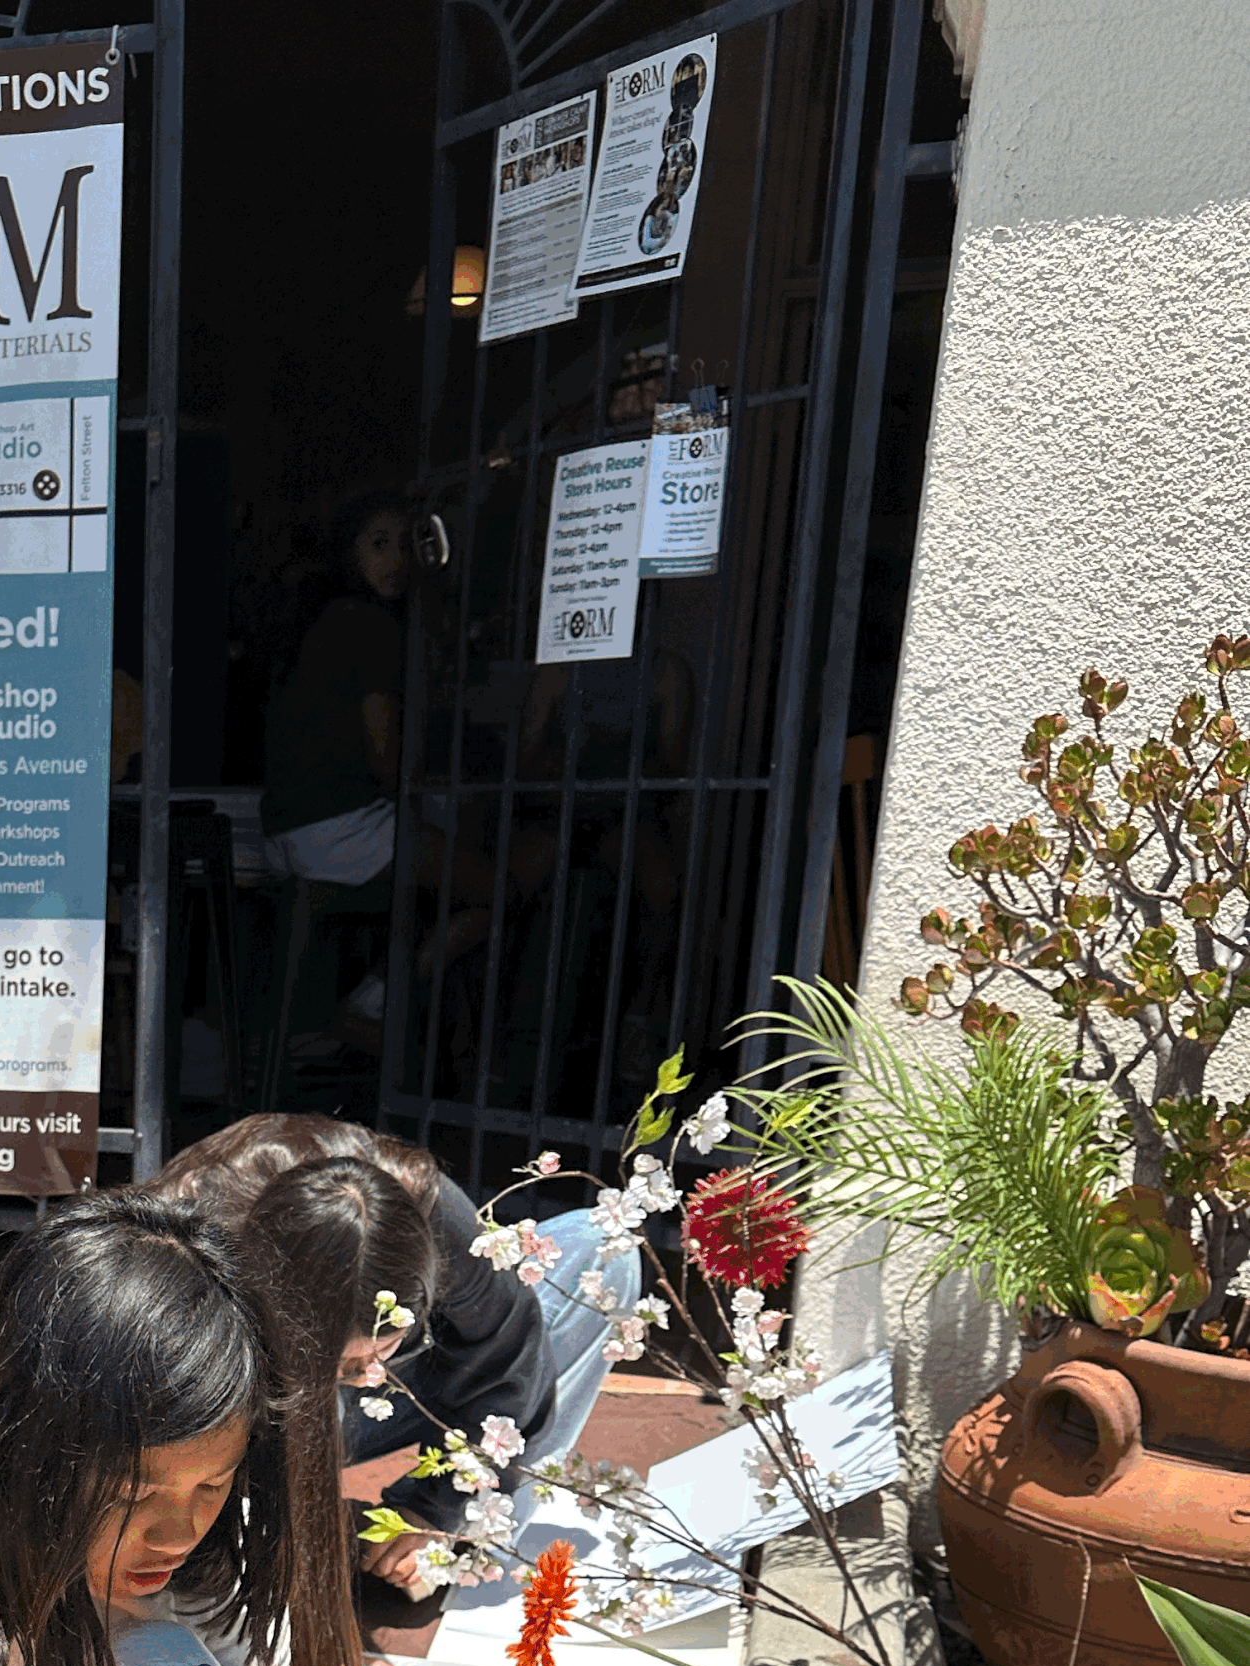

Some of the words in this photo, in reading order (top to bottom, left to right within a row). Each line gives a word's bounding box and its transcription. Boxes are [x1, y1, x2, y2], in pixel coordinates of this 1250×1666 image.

[19, 423, 34, 432] Art
[82, 415, 92, 456] Street
[560, 462, 602, 481] Creative
[605, 456, 646, 472] Reuse
[80, 459, 92, 502] Felton
[565, 483, 592, 498] Store
[594, 476, 632, 493] Hours
[660, 481, 720, 505] Store
[14, 756, 88, 774] Avenue
[3, 949, 32, 970] go
[39, 946, 64, 967] to
[0, 977, 76, 998] intake.
[36, 1112, 81, 1134] visit
